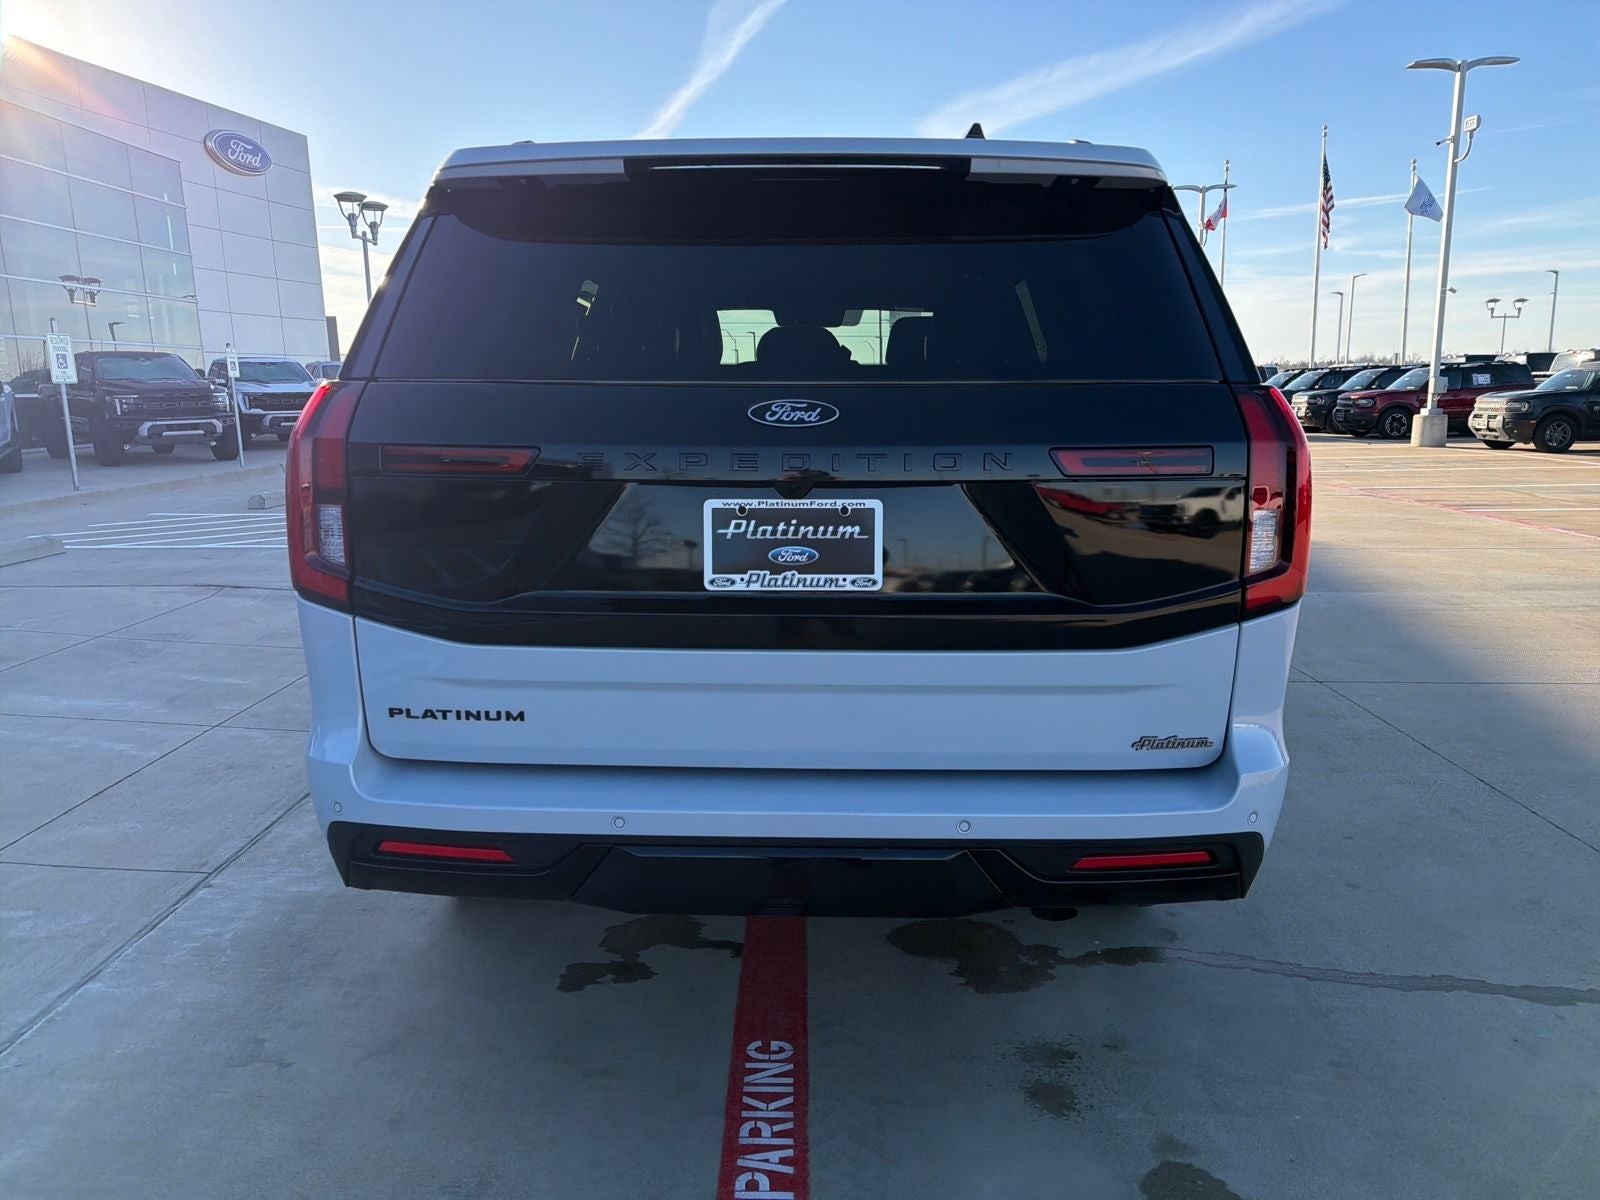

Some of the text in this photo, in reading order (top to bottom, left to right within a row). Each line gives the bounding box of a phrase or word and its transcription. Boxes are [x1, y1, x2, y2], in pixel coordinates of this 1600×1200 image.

[228, 139, 262, 167] Ford
[765, 402, 822, 422] Ford
[581, 452, 1014, 472] EXPEDITION
[721, 500, 866, 508] www.PlatinumFord.com
[716, 519, 869, 539] Platinum
[778, 549, 809, 562] Ford
[743, 572, 847, 588] Platinum
[388, 707, 526, 722] PLATINUM
[1131, 735, 1214, 751] Platinum
[734, 1040, 794, 1200] PARKING
